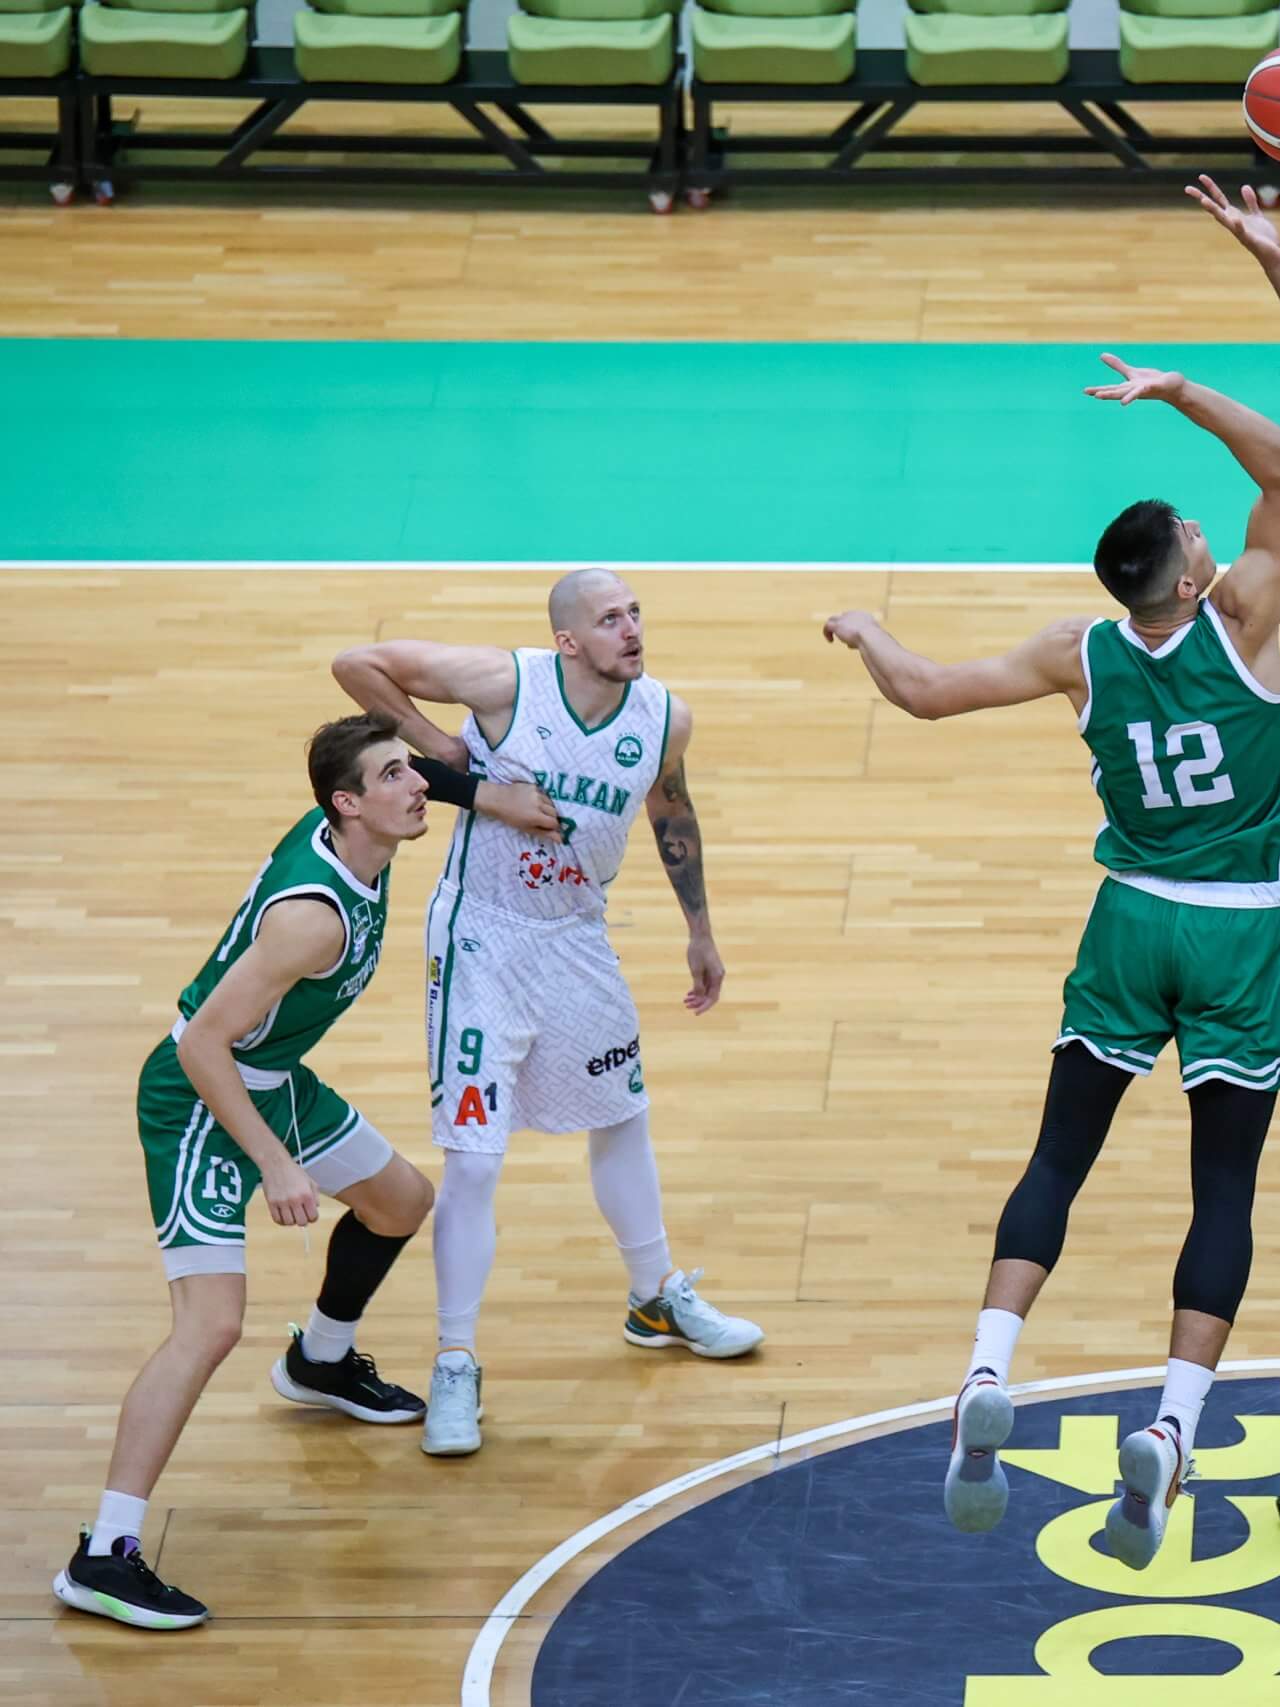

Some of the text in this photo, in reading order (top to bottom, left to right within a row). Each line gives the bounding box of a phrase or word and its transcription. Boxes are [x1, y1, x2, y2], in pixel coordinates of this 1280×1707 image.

[1126, 720, 1235, 809] 12
[457, 1027, 484, 1076] 9
[453, 1082, 498, 1126] A1
[202, 1155, 242, 1204] 13
